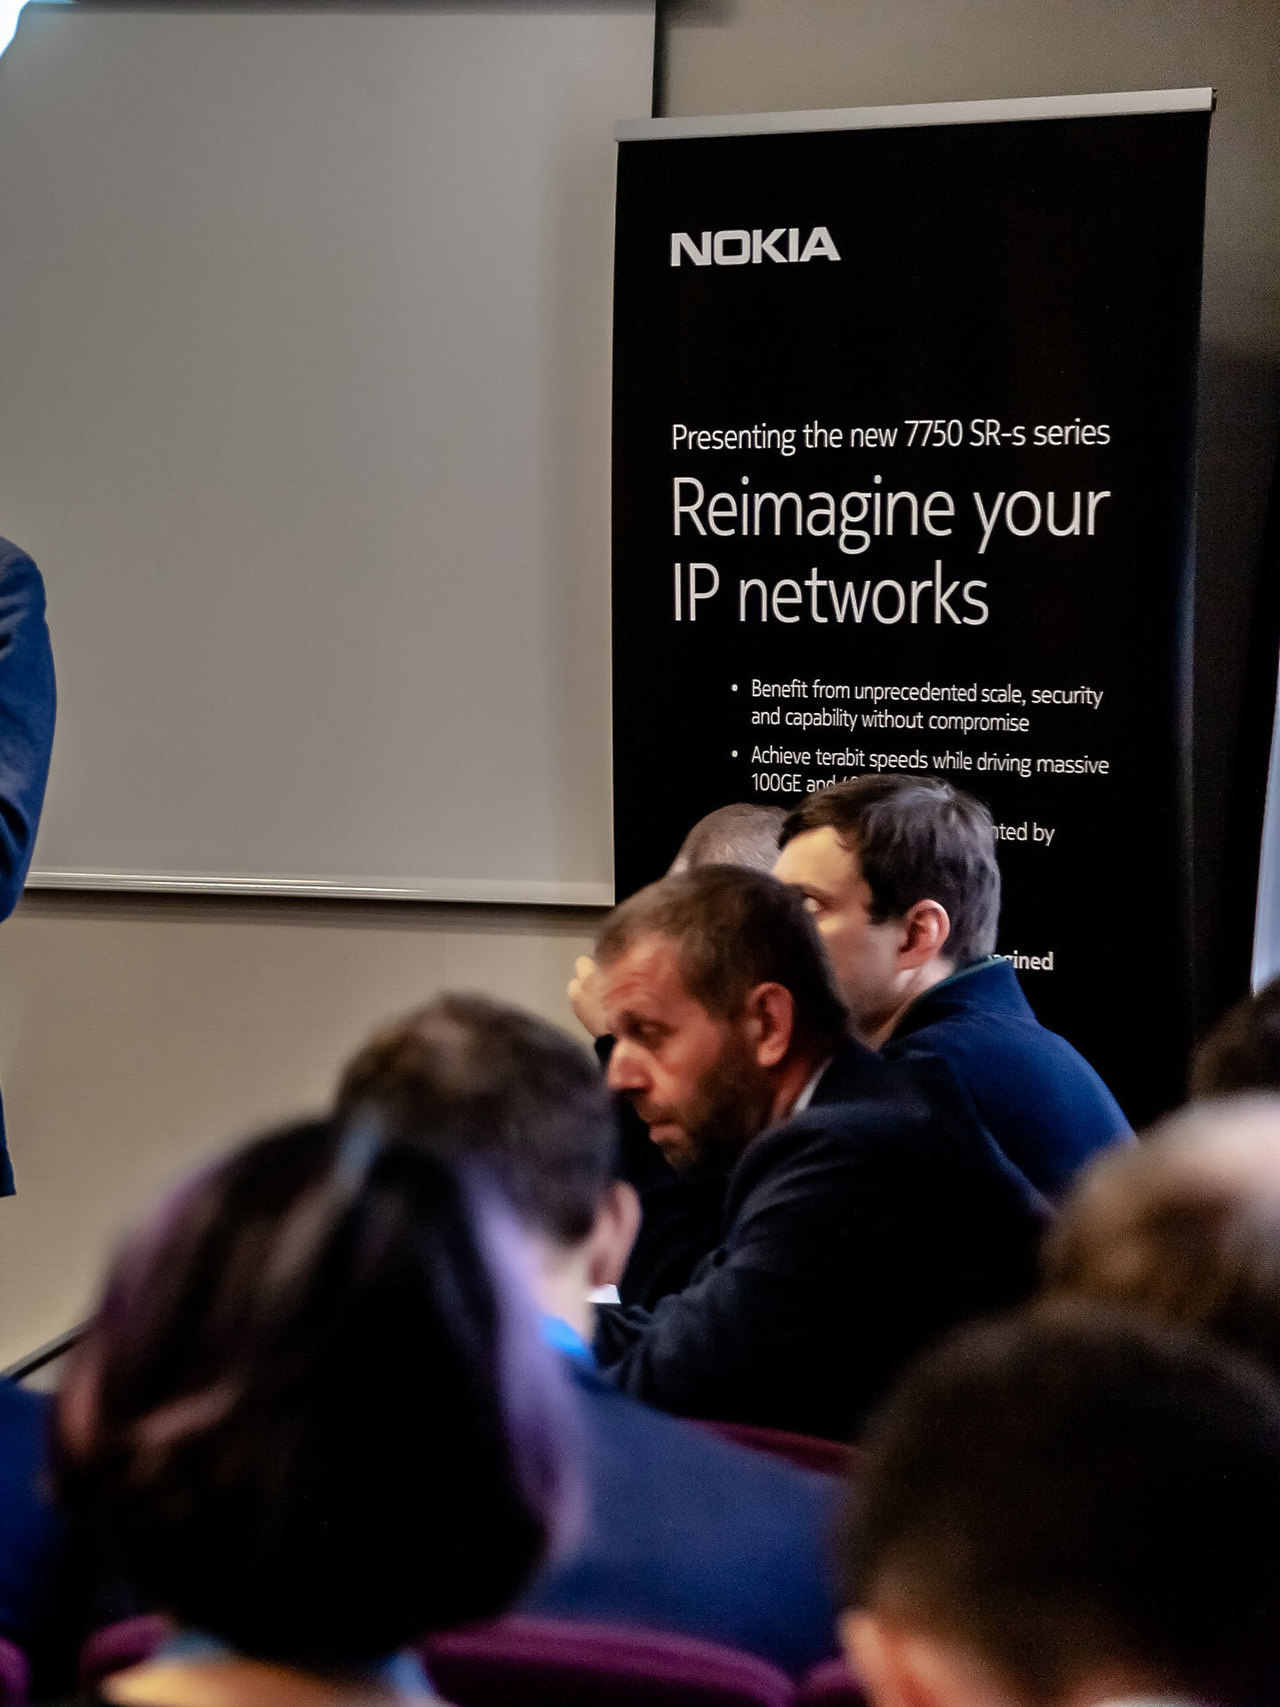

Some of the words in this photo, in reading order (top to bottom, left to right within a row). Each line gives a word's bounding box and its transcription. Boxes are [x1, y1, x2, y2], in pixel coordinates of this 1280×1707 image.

[670, 226, 842, 267] NOKIA
[672, 422, 797, 457] Presenting
[801, 419, 844, 449] the
[850, 427, 899, 448] new
[903, 418, 963, 447] 7750
[968, 418, 1027, 447] SR-s
[1032, 417, 1111, 446] series
[673, 474, 956, 555] Reimagine
[972, 490, 1112, 555] your
[674, 562, 720, 622] IP
[739, 559, 989, 626] networks
[751, 678, 809, 699] Benefit
[812, 678, 851, 699] from
[854, 681, 977, 705] unprecedented
[980, 683, 1027, 707] scale,
[1031, 685, 1104, 710] security
[751, 706, 781, 725] and
[785, 707, 858, 732] capability
[861, 709, 924, 729] without
[928, 712, 1030, 735] compromise
[751, 744, 811, 765] Achieve
[815, 747, 866, 767] terabit
[869, 749, 928, 772] speeds
[932, 750, 973, 771] while
[976, 751, 1032, 778] driving
[1036, 755, 1110, 775] massive
[751, 772, 803, 793] 100GE
[806, 774, 836, 793] and
[1032, 822, 1055, 847] by
